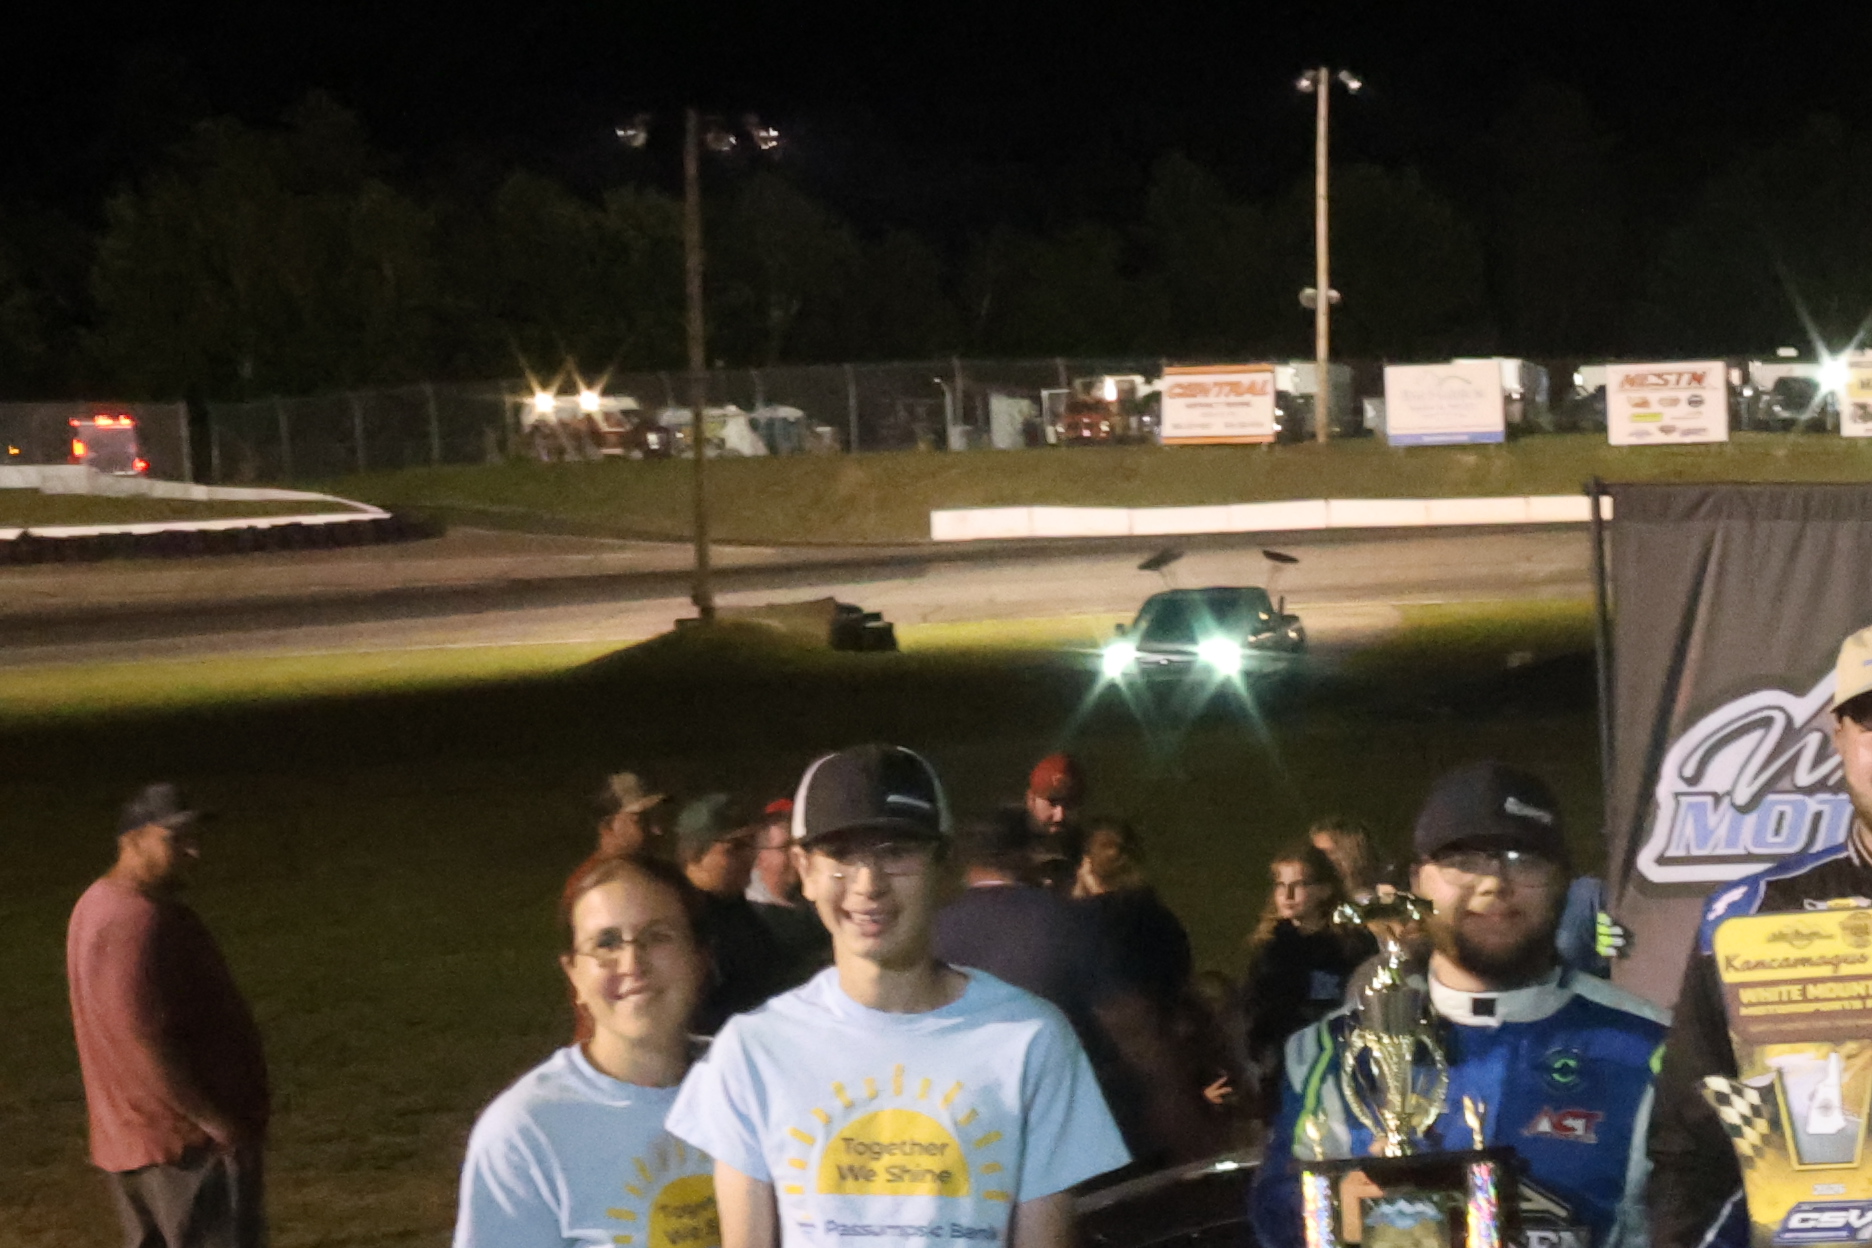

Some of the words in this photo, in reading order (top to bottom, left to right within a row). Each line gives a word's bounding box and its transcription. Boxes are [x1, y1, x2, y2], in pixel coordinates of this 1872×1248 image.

[1738, 984, 1804, 1005] WHITE
[841, 1136, 949, 1162] Together
[837, 1162, 879, 1184] We
[885, 1161, 952, 1185] Shine
